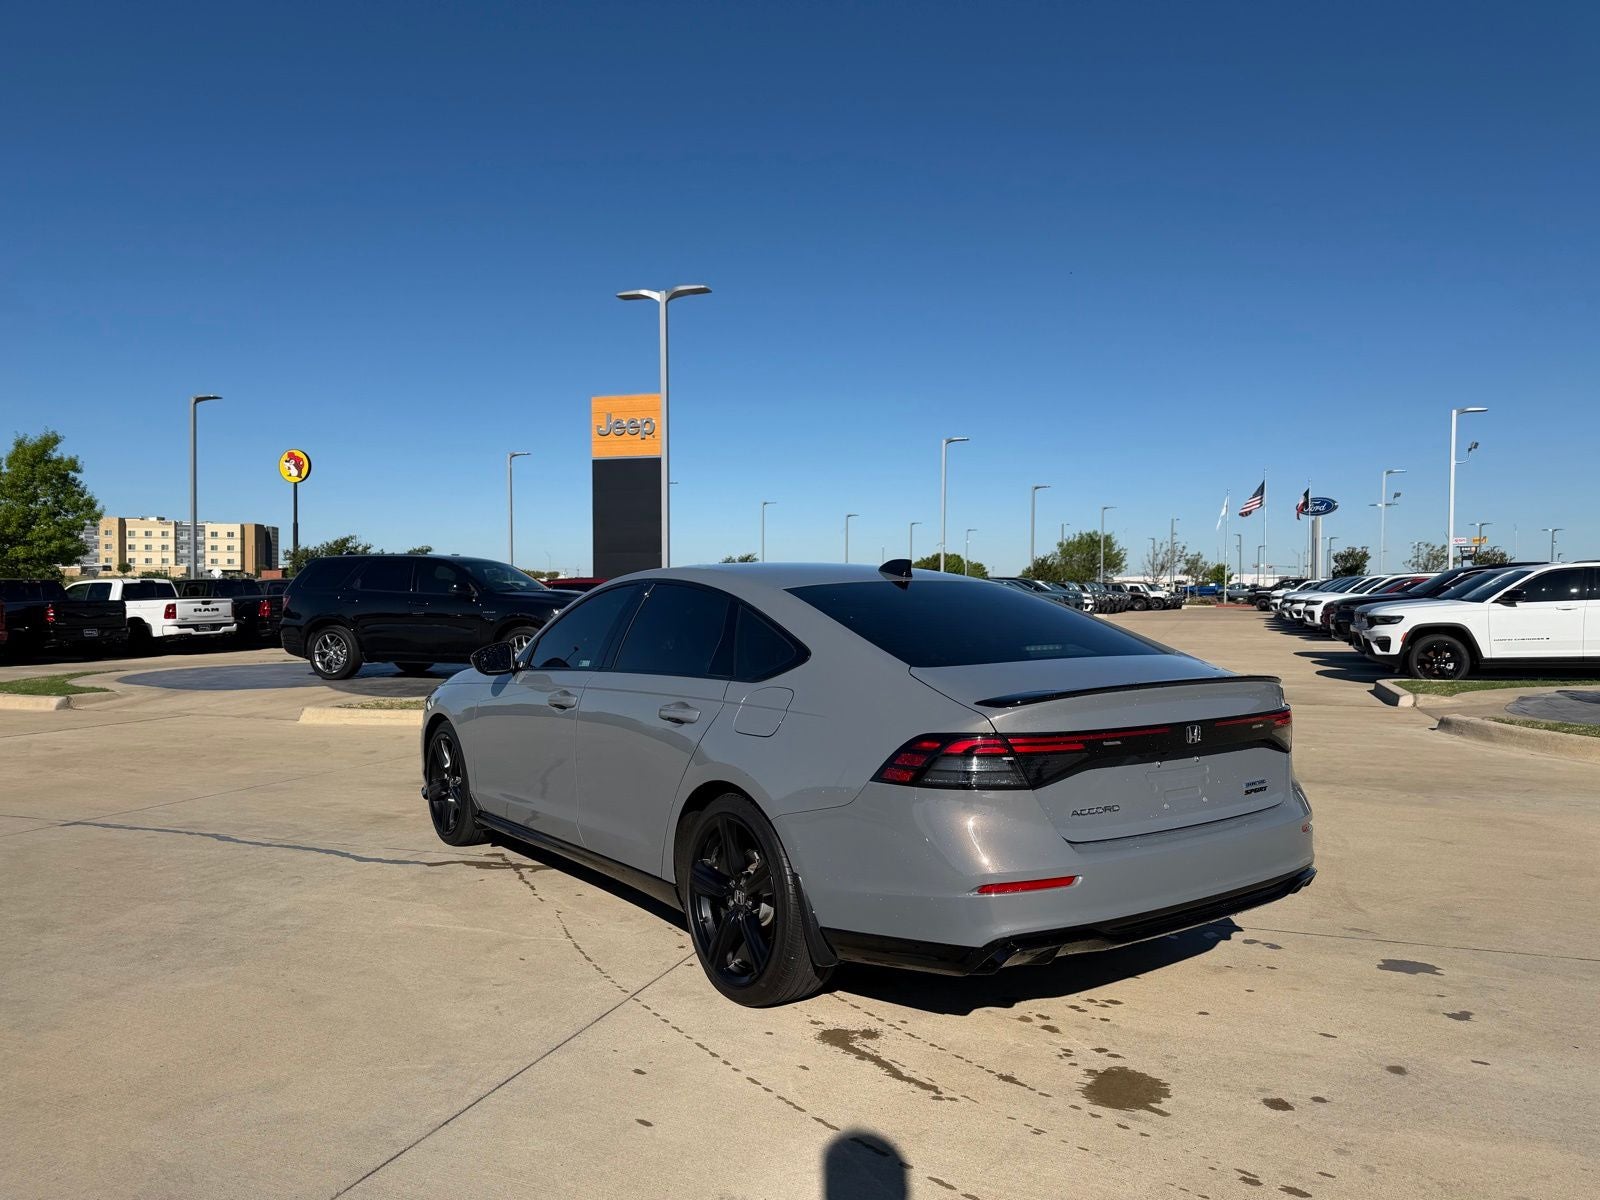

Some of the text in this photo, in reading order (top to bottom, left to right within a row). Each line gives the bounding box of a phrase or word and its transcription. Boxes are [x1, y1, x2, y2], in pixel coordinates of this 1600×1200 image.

[596, 412, 656, 440] Jeep
[1244, 786, 1268, 795] SPORT
[1071, 804, 1120, 817] ACCORD
